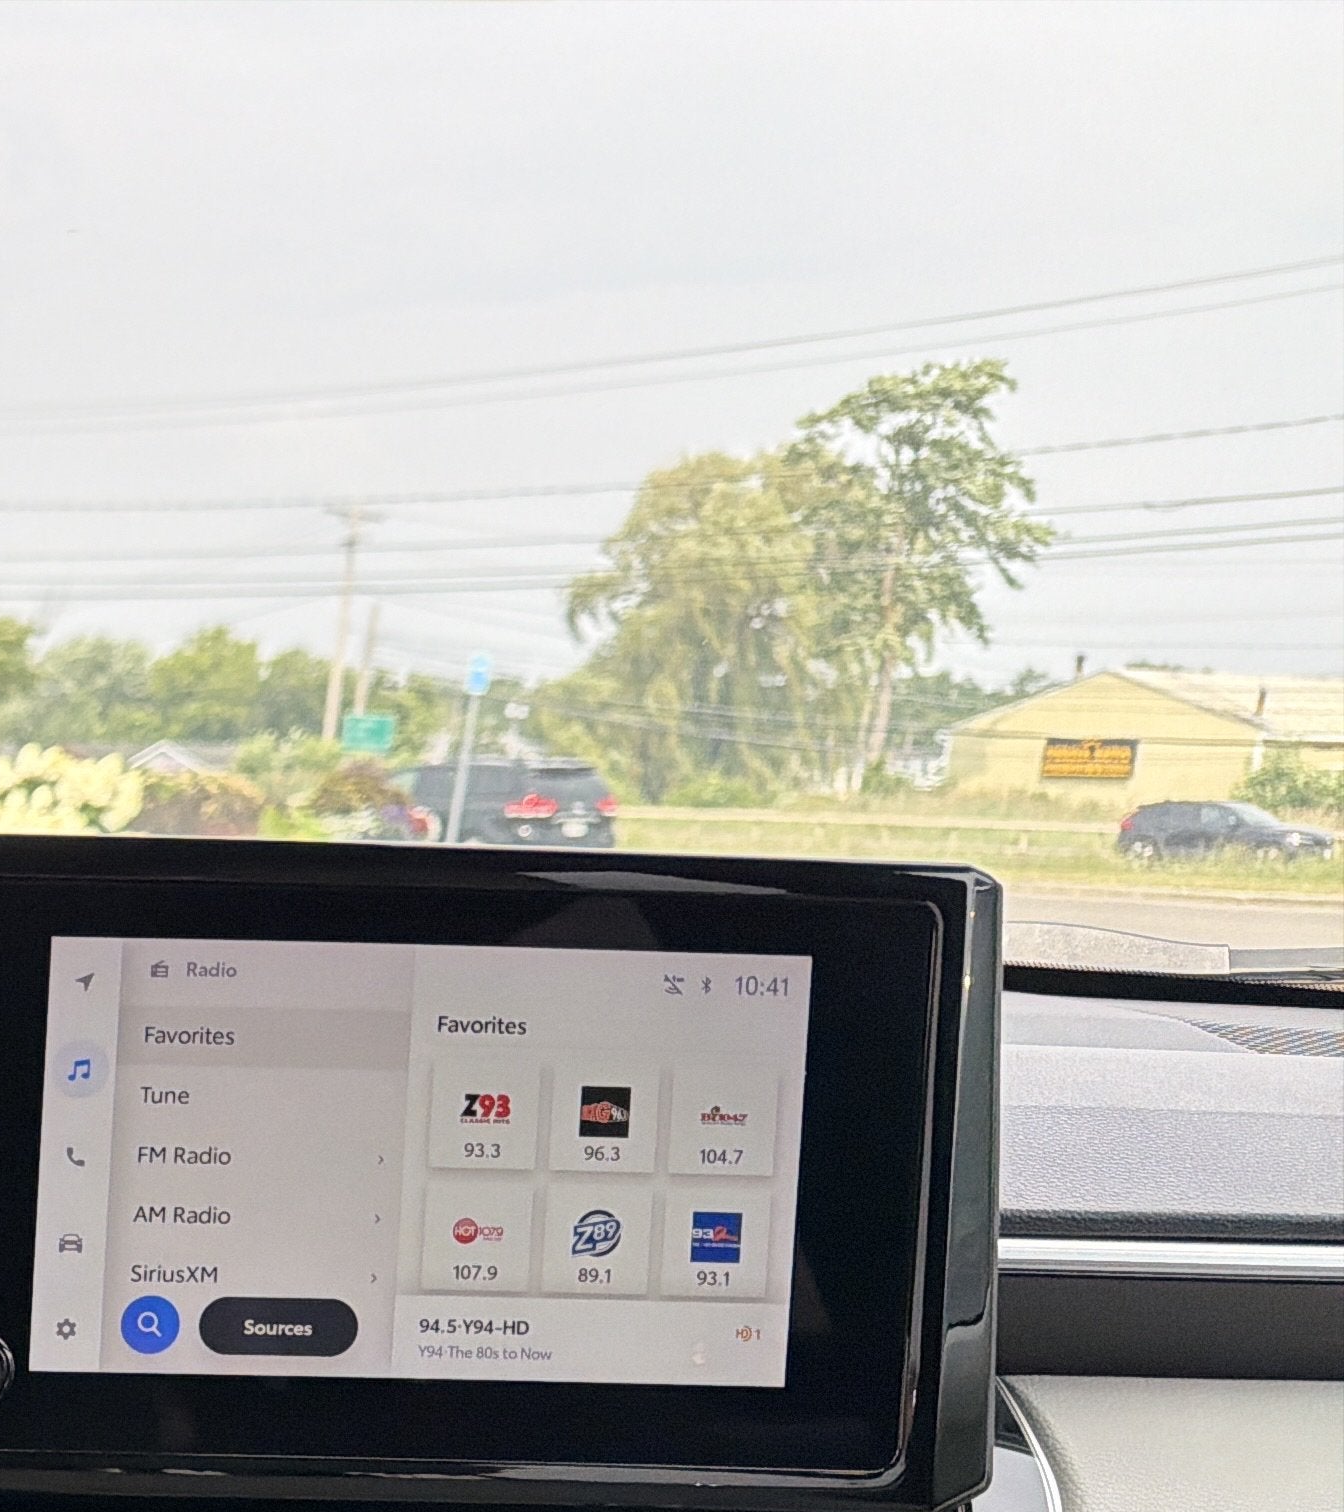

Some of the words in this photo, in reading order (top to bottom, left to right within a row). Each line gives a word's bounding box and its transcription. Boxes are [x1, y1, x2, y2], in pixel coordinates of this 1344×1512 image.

[185, 961, 238, 979] Radio
[735, 975, 790, 997] 10:41
[437, 1015, 528, 1036] Favorites
[143, 1026, 236, 1046] Favorites
[140, 1086, 191, 1105] Tune
[461, 1093, 511, 1119] Z93
[137, 1146, 167, 1164] FM
[173, 1147, 232, 1166] Radio
[463, 1143, 502, 1159] 93.3
[583, 1146, 621, 1162] 96.3
[699, 1149, 744, 1165] 104.7
[132, 1206, 167, 1224] AM
[173, 1206, 231, 1225] Radio
[454, 1226, 476, 1237] HOT
[573, 1220, 619, 1253] Z89
[130, 1265, 219, 1284] SiriusXM
[451, 1265, 499, 1281] 107.9
[577, 1268, 613, 1284] 89.1
[696, 1270, 731, 1287] 93.1
[243, 1319, 313, 1337] Sources
[475, 1346, 500, 1360] 80s
[502, 1347, 518, 1360] to
[520, 1347, 553, 1361] Now
